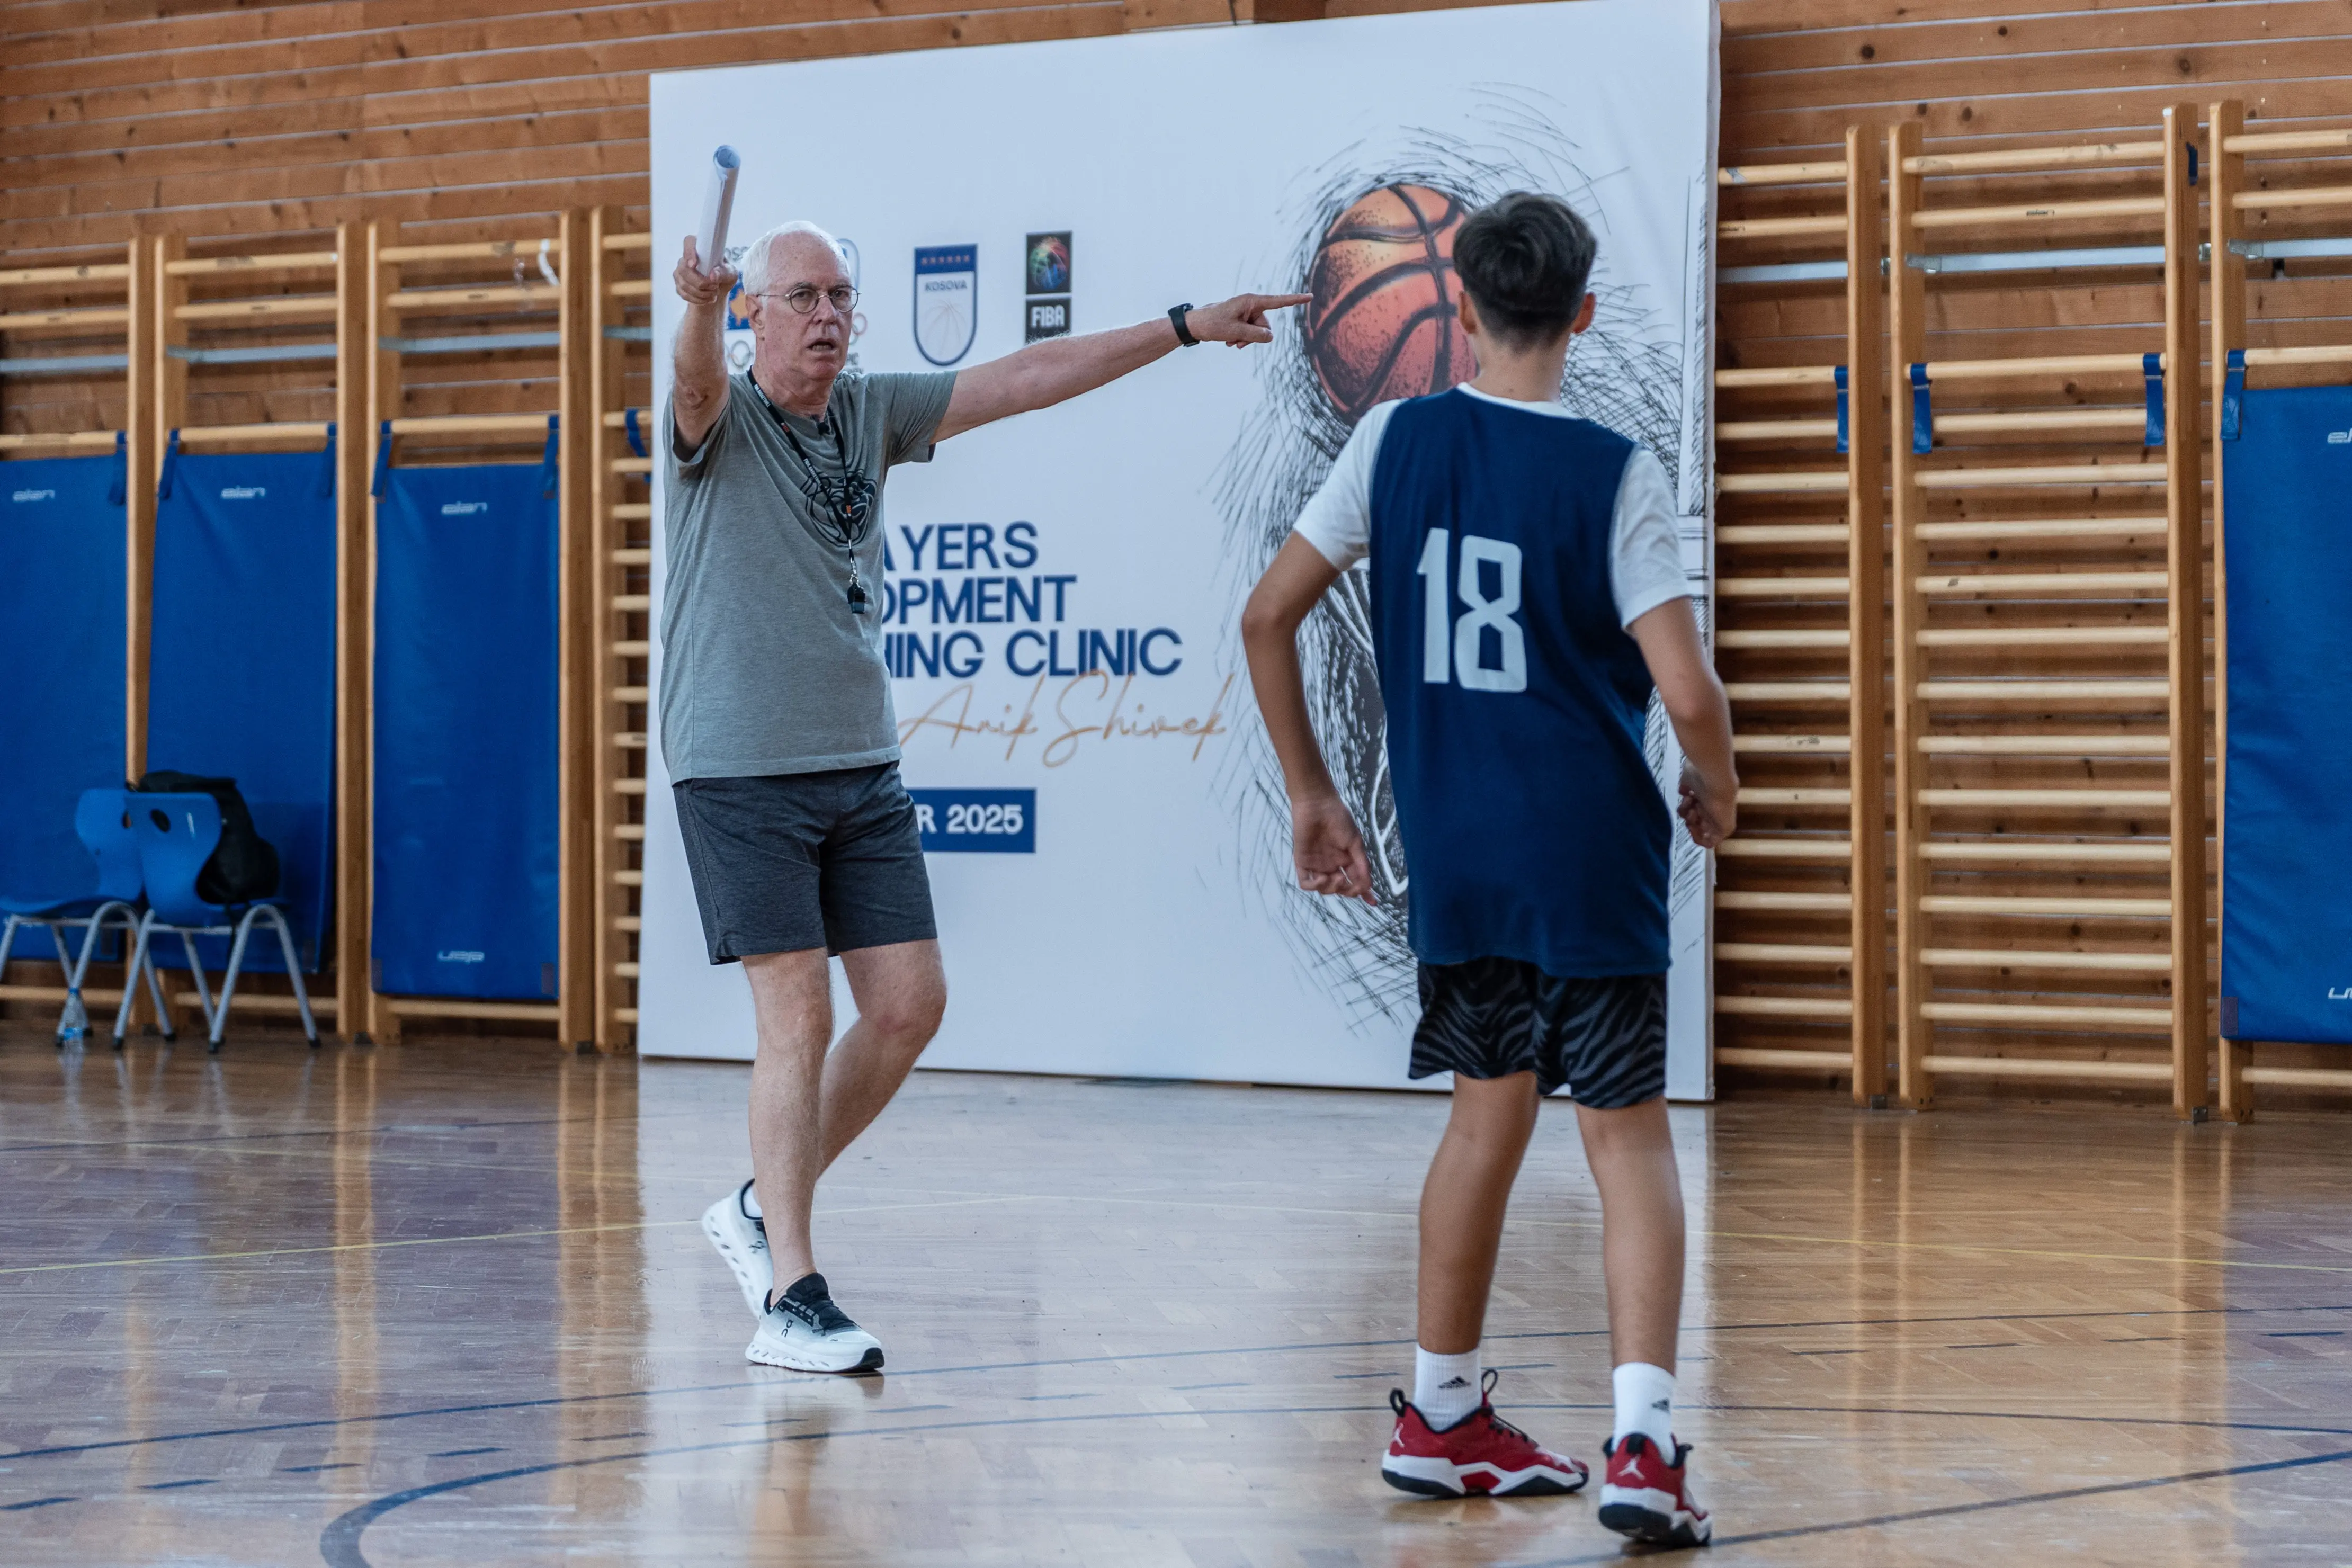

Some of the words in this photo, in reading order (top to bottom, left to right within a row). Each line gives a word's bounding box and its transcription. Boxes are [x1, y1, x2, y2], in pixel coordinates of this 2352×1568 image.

[925, 279, 968, 292] KOSOVA
[1031, 305, 1065, 328] FIBA
[884, 521, 1039, 571] YERS
[1417, 527, 1527, 693] 18
[1006, 628, 1184, 677] CLINIC
[946, 804, 1024, 835] 2025
